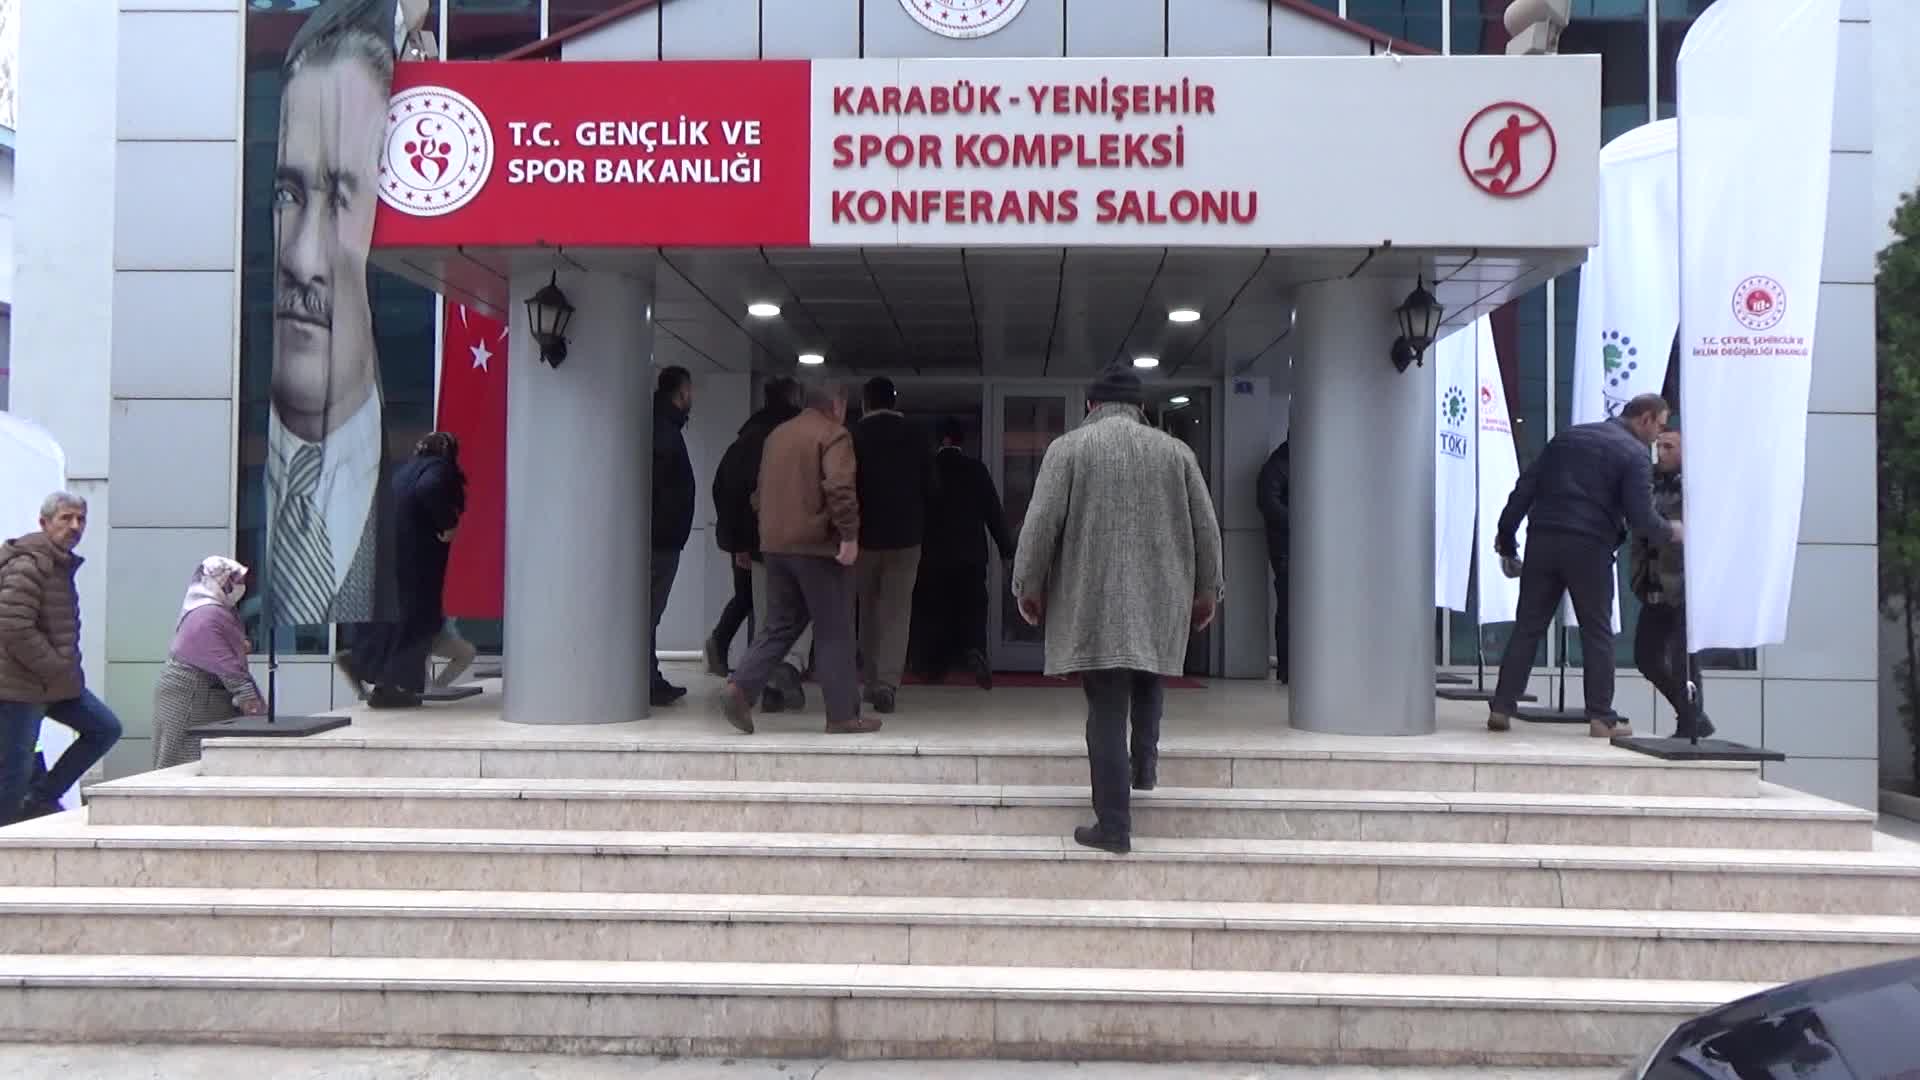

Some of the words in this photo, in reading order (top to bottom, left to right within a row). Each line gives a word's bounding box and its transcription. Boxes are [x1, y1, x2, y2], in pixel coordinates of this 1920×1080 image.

[833, 81, 1001, 114] KARABÜK
[1027, 77, 1215, 121] YENİŞEHİR
[508, 121, 560, 147] T.C.
[575, 115, 709, 152] GENÇLİK
[721, 121, 761, 145] VE
[832, 134, 942, 168] SPOR
[955, 125, 1184, 168] KOMPLEKSİ
[508, 159, 585, 183] SPOR
[595, 152, 761, 183] BAKANLIĞI
[832, 189, 1079, 224] KONFERANS
[1096, 189, 1258, 224] SALONU
